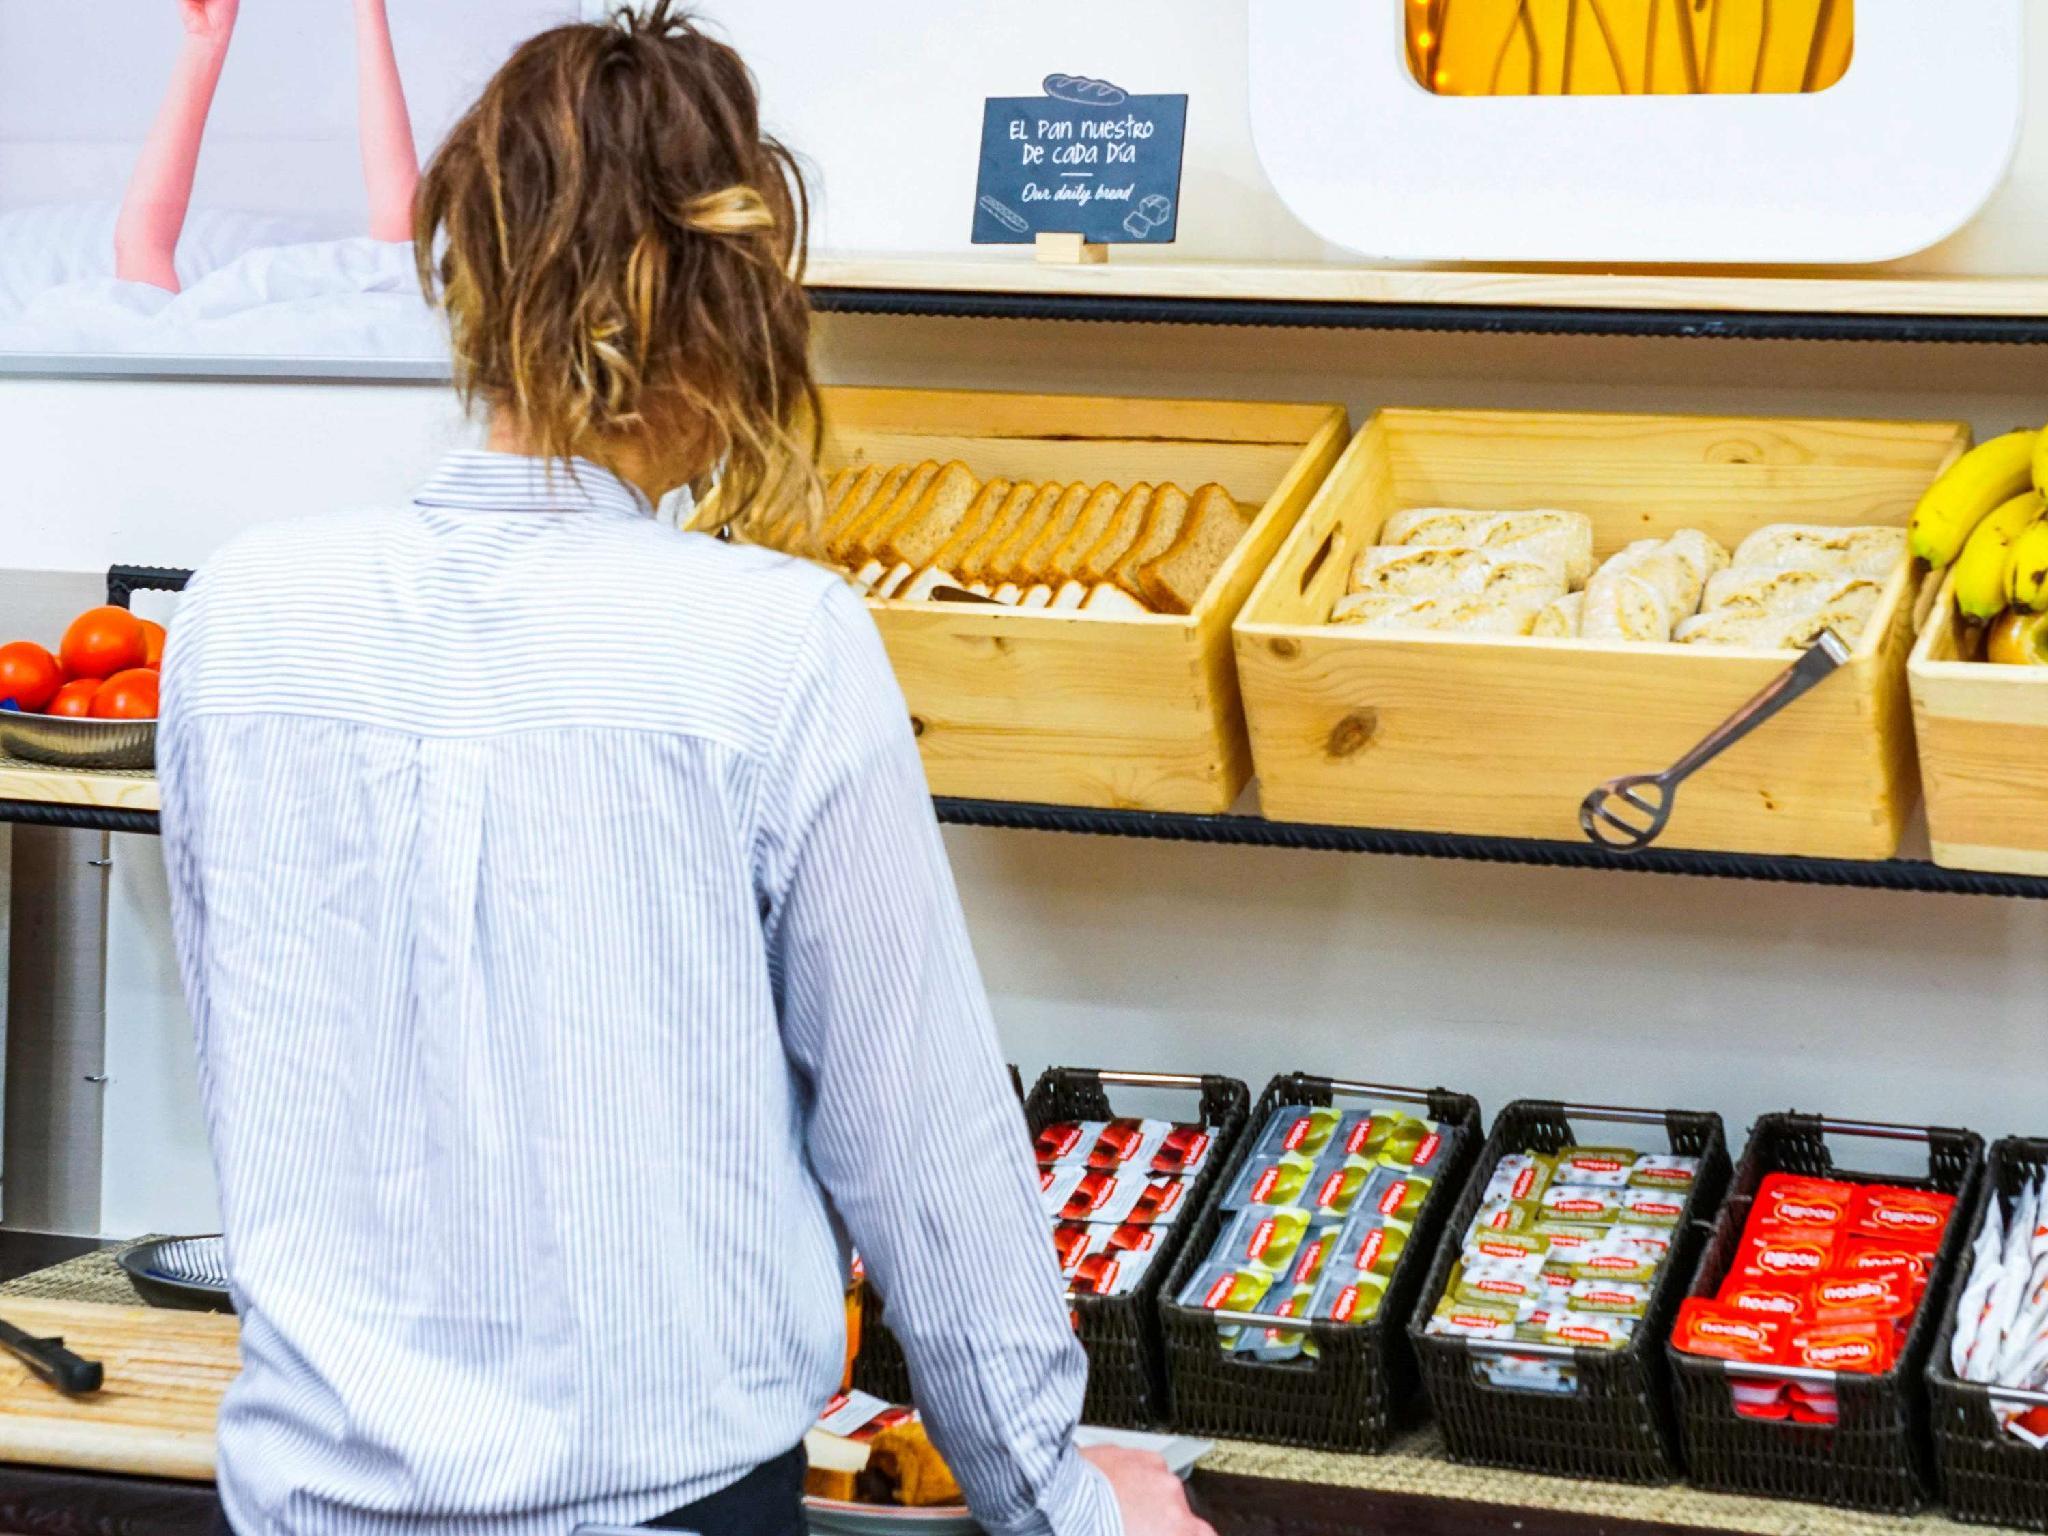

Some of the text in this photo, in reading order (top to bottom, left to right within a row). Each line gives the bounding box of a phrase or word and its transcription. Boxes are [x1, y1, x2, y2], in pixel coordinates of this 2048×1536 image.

[1022, 182, 1135, 206] Our daily bread
